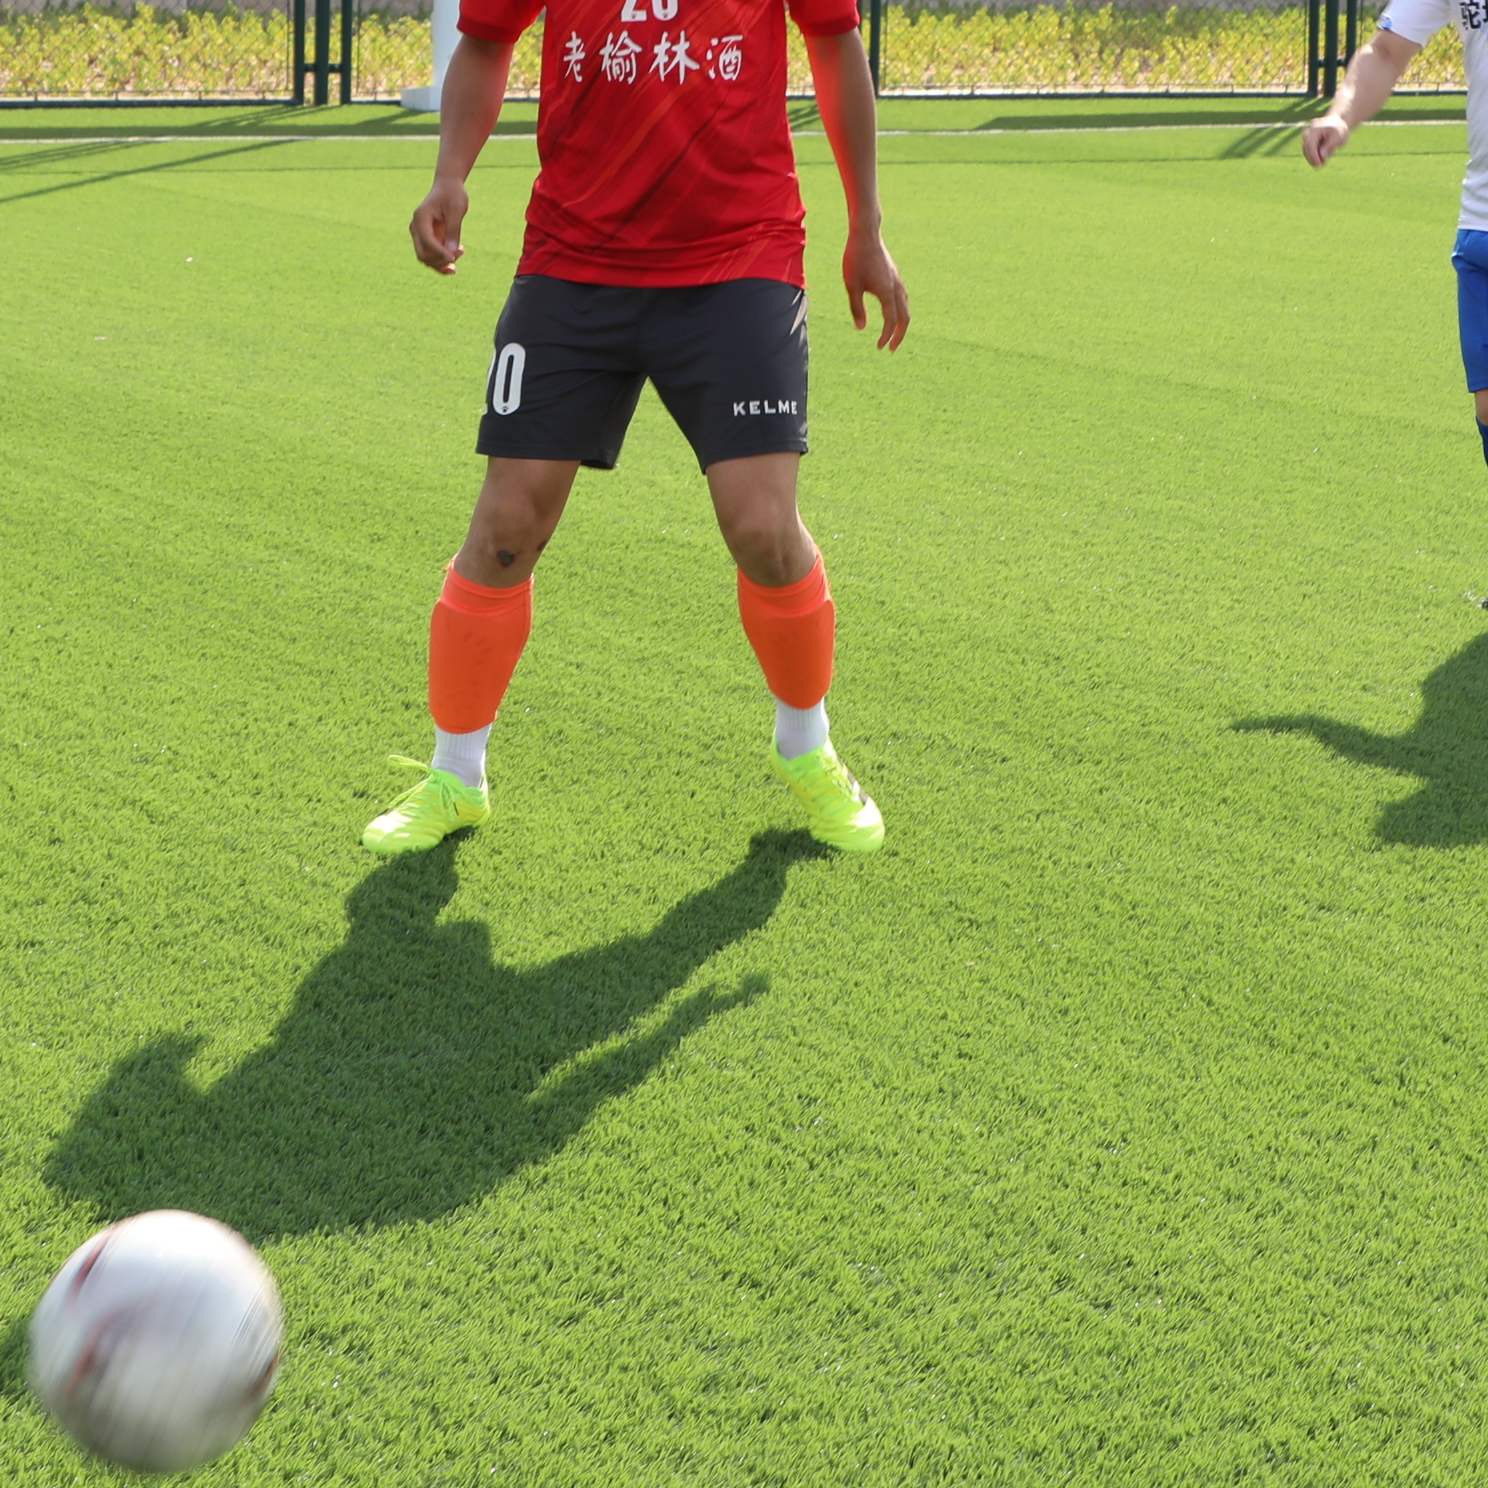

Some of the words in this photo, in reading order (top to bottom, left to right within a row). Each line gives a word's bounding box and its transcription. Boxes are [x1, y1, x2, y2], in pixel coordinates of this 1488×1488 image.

[562, 29, 744, 85] 老榆林酒
[486, 342, 526, 416] 0
[733, 400, 798, 417] KELME
